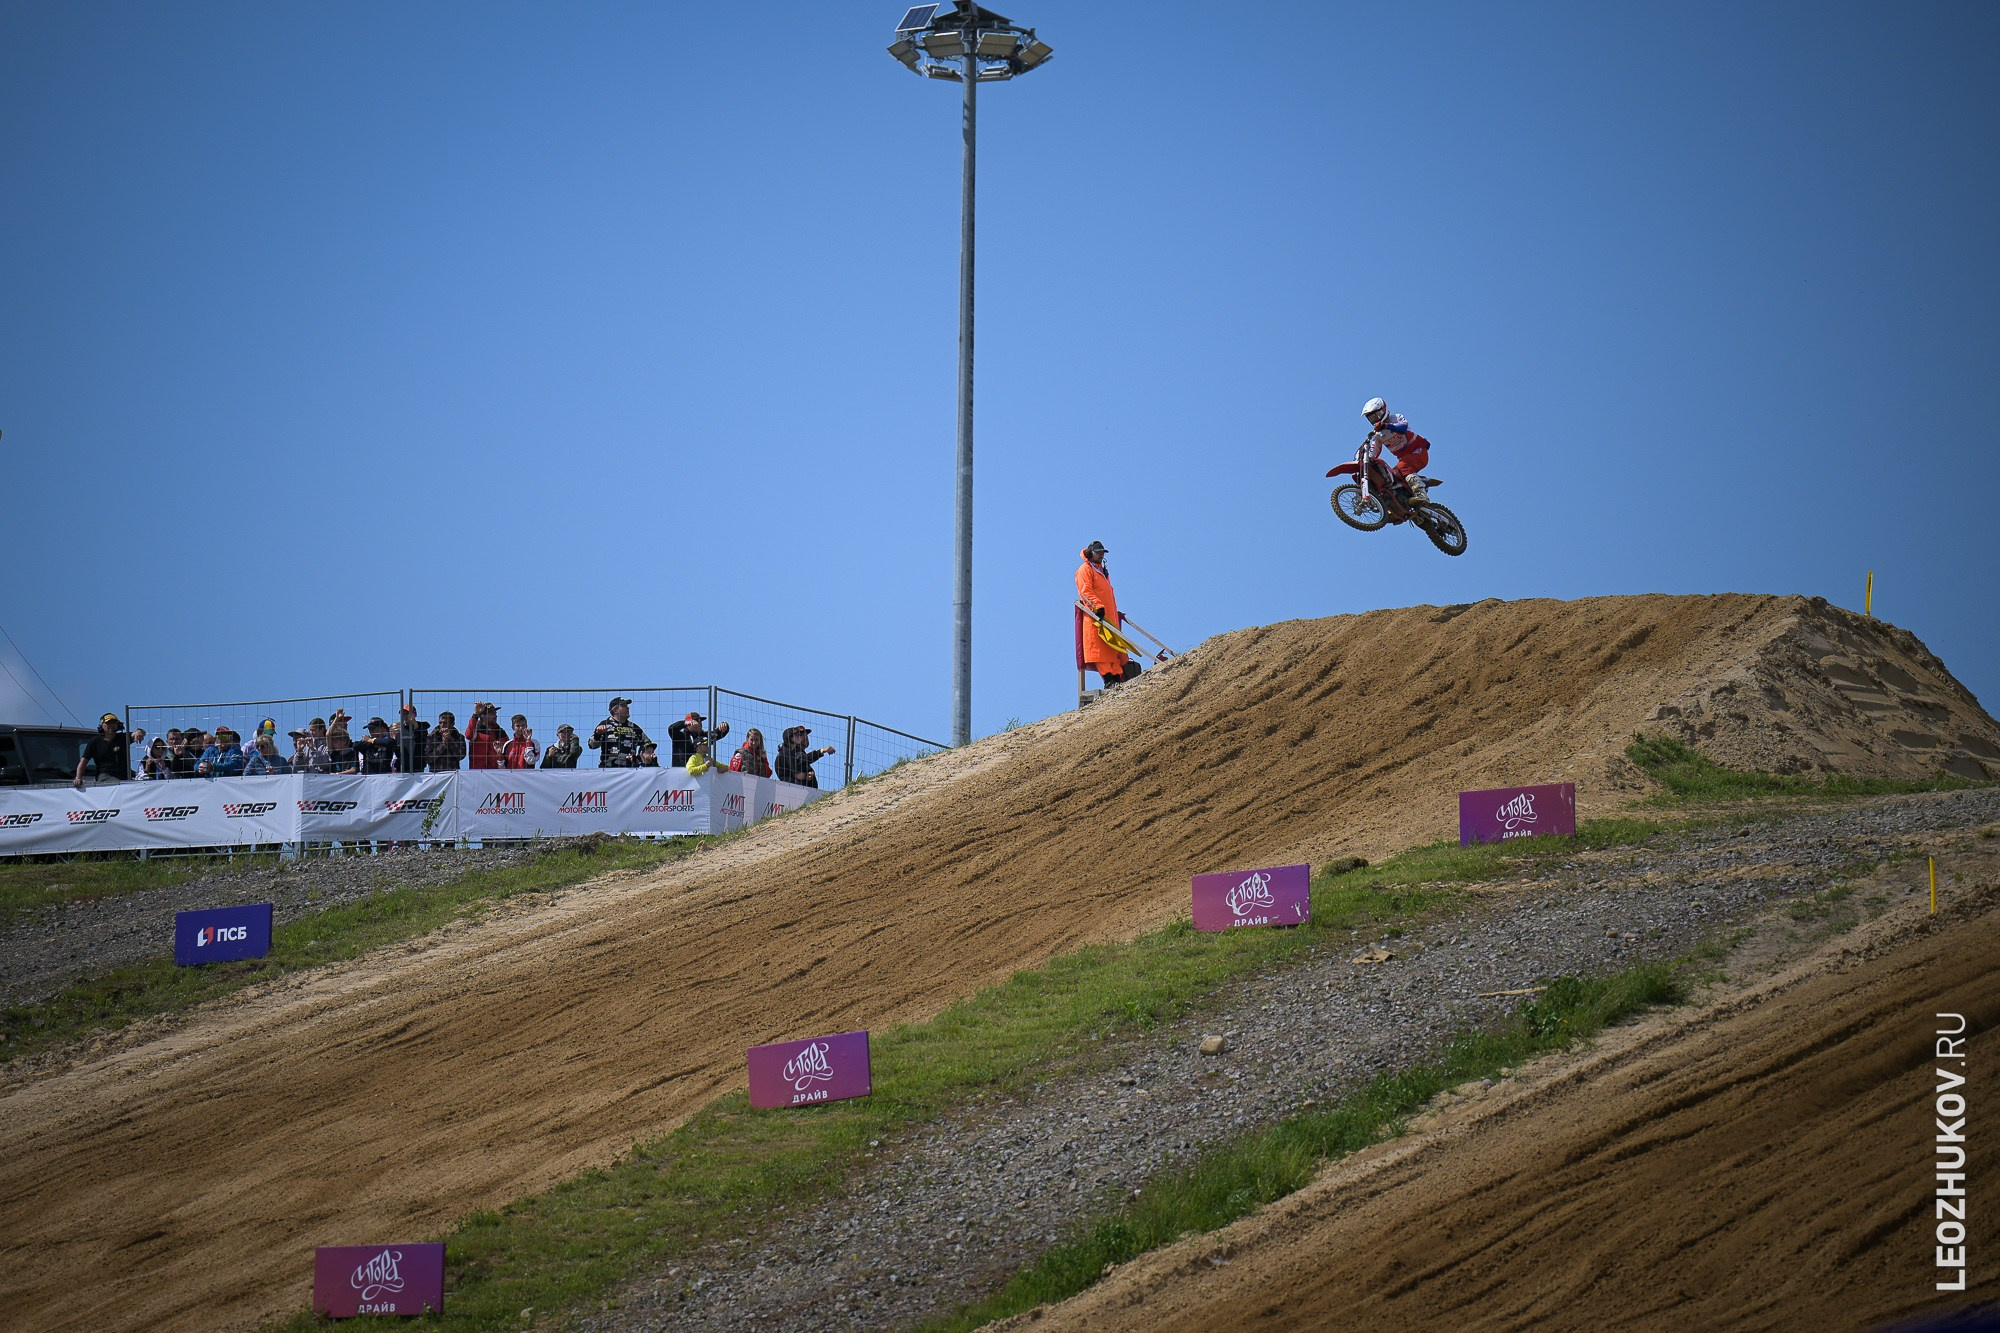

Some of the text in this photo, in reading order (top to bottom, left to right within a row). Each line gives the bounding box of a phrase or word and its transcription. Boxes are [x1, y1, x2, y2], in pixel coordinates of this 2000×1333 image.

[158, 805, 199, 817] RGP
[237, 802, 277, 814] RGP
[313, 800, 358, 811] RGP
[3, 813, 43, 825] RGP
[80, 809, 120, 821] RGP
[1502, 829, 1532, 839] ДРАЙВ
[1234, 915, 1268, 927] ДРАЙВ
[217, 926, 247, 942] ПСБ
[792, 1090, 828, 1103] ДРАЙВ
[357, 1301, 396, 1314] ДРАЙВ
